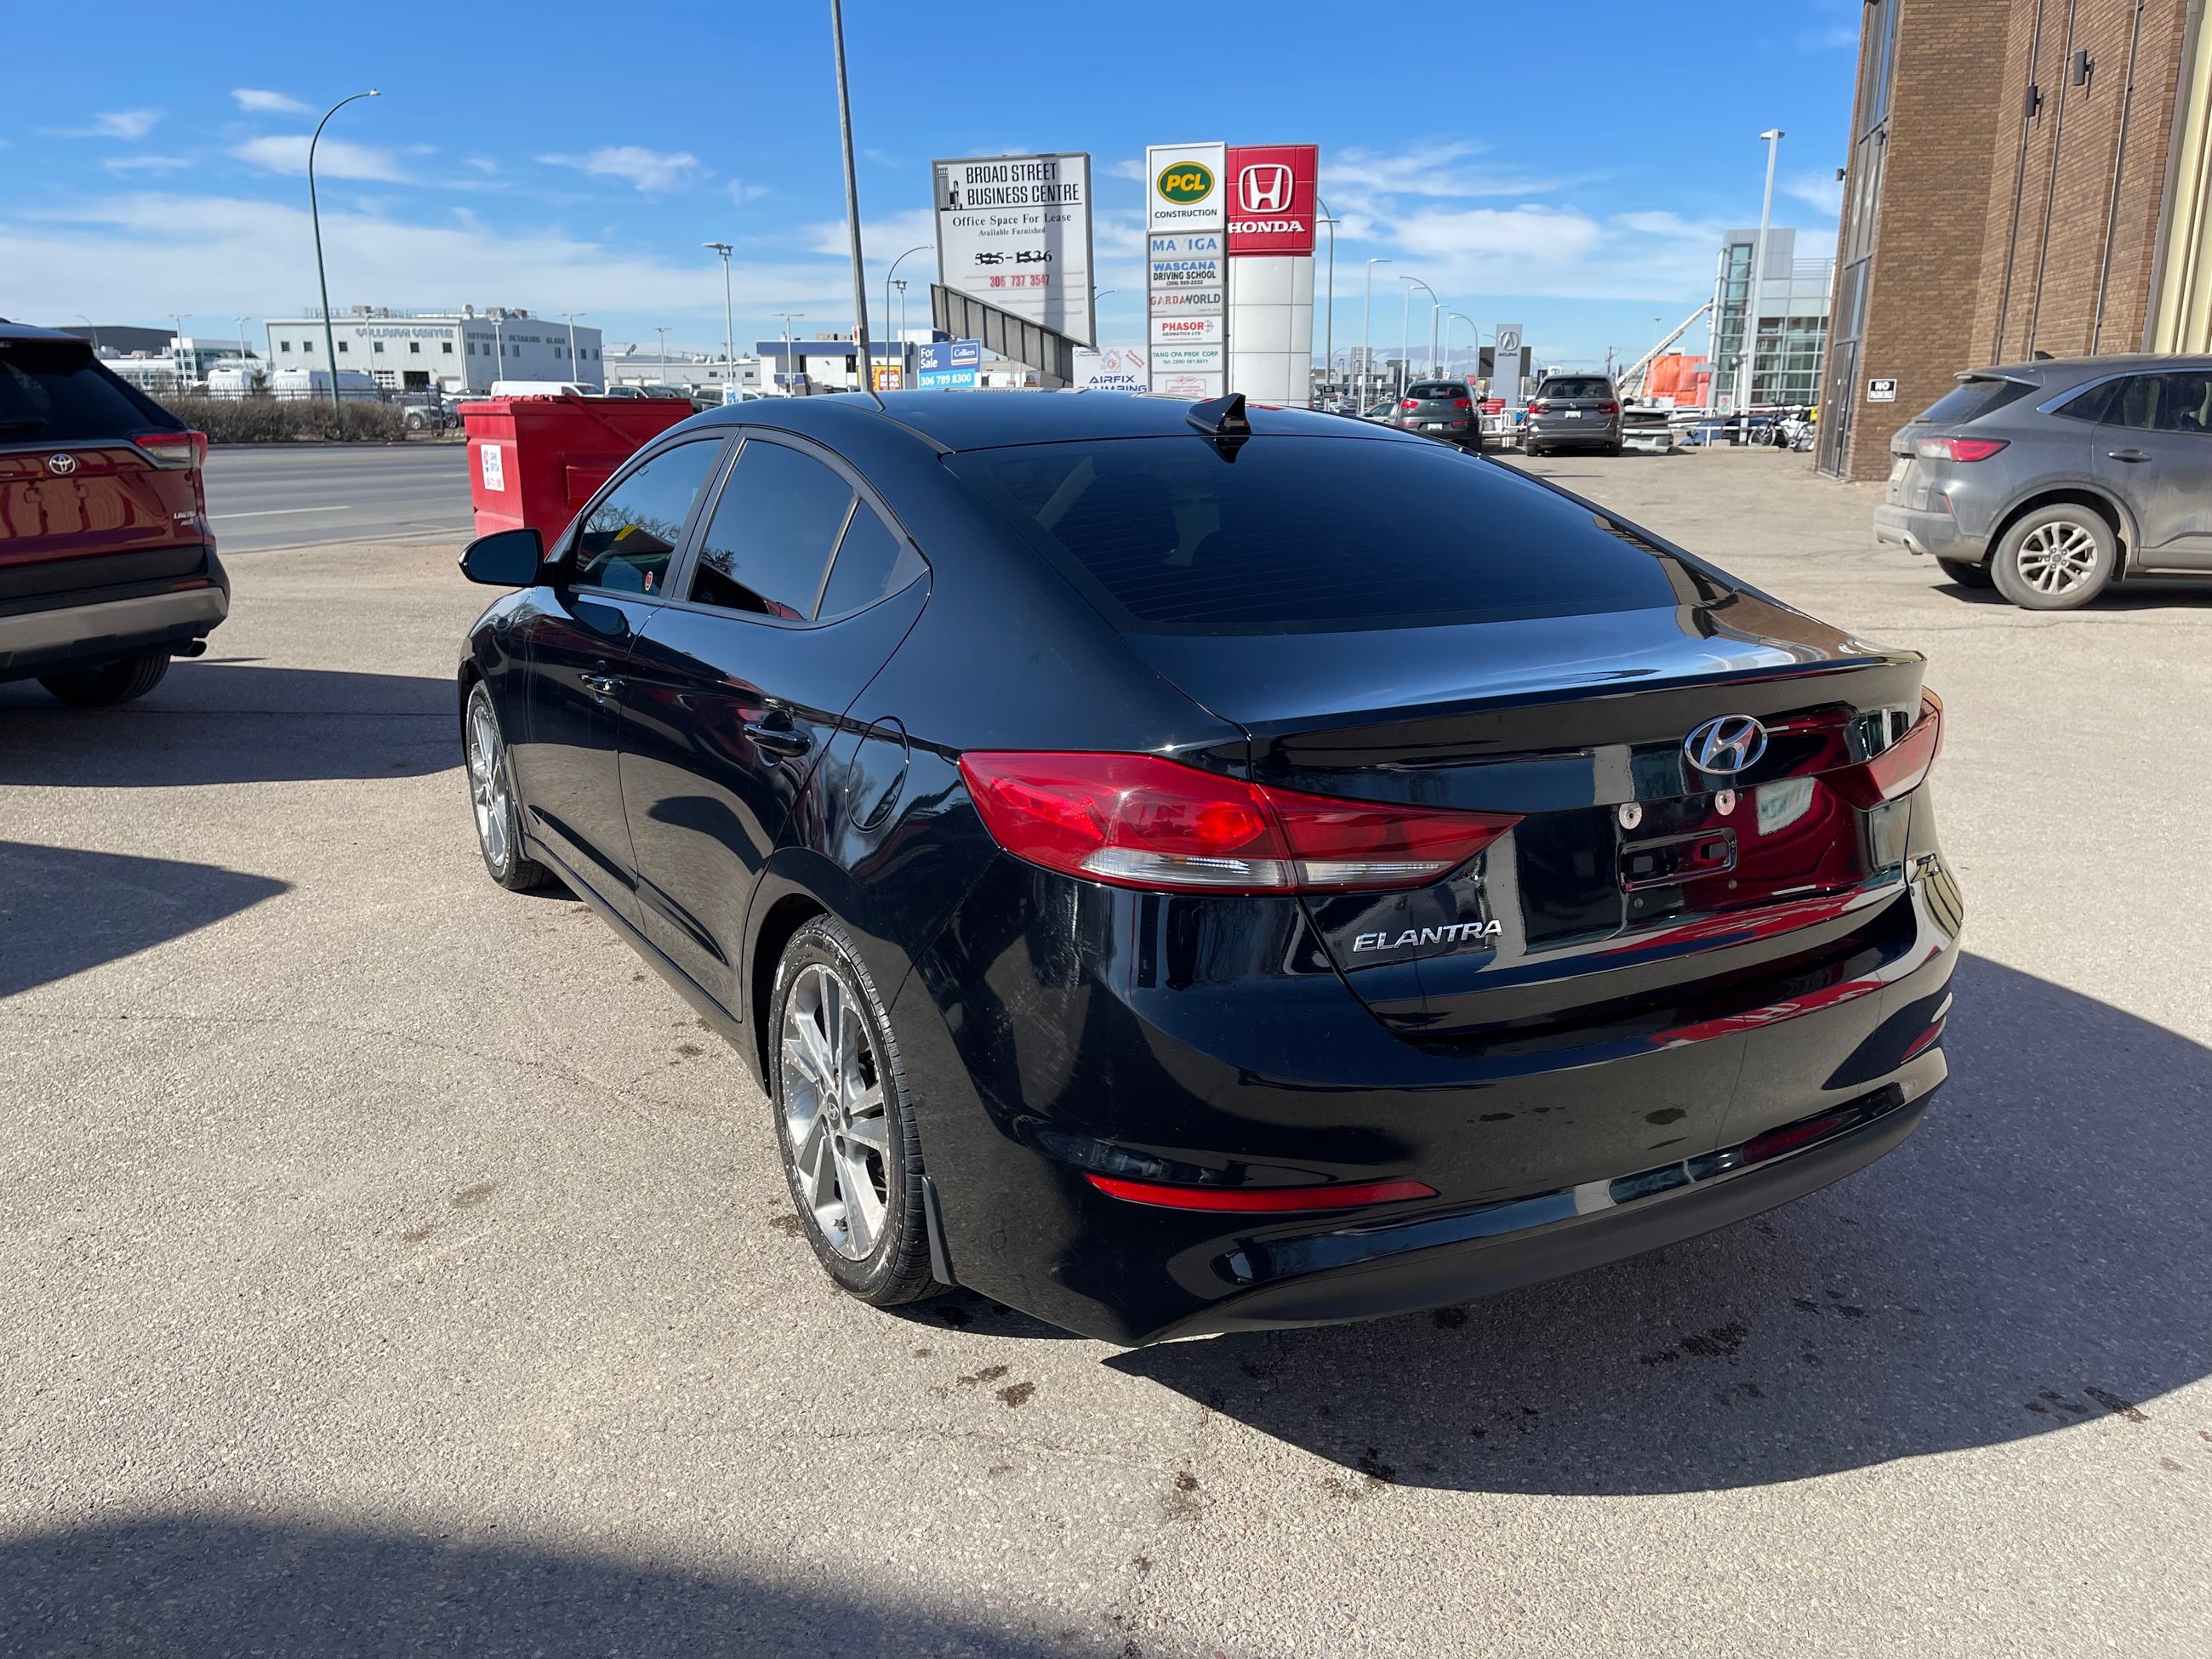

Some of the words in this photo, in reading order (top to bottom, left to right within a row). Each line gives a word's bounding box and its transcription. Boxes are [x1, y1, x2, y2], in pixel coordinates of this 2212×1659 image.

[966, 165, 1007, 184] BROAD
[1012, 162, 1057, 182] STREET
[1166, 174, 1206, 192] PCL
[967, 185, 1028, 205] BUSINESS
[1032, 184, 1079, 202] CENTRE
[1154, 208, 1217, 219] CONSTRUCTION
[953, 215, 985, 227] Office
[989, 214, 1018, 226] Space
[1023, 214, 1039, 224] For
[1044, 213, 1072, 223] Lease
[978, 228, 1009, 237] Available
[1012, 226, 1046, 235] Furnished
[1228, 220, 1305, 234] HONDA
[1154, 261, 1216, 271] WASCANA
[989, 276, 1006, 288] 306
[1011, 274, 1025, 287] 737
[1029, 273, 1051, 287] 3547
[1154, 271, 1183, 281] DRIVING
[1186, 271, 1217, 279] SCHOOL
[1161, 322, 1205, 331] PHASOR
[921, 347, 935, 358] For
[954, 348, 975, 356] Colliers
[921, 357, 938, 368] Sale
[921, 376, 935, 386] 306
[936, 374, 950, 385] 789
[951, 373, 972, 384] 8300
[1089, 375, 1135, 384] AIRFIX
[1875, 381, 1890, 391] NO
[1353, 919, 1503, 953] ELANTRA
